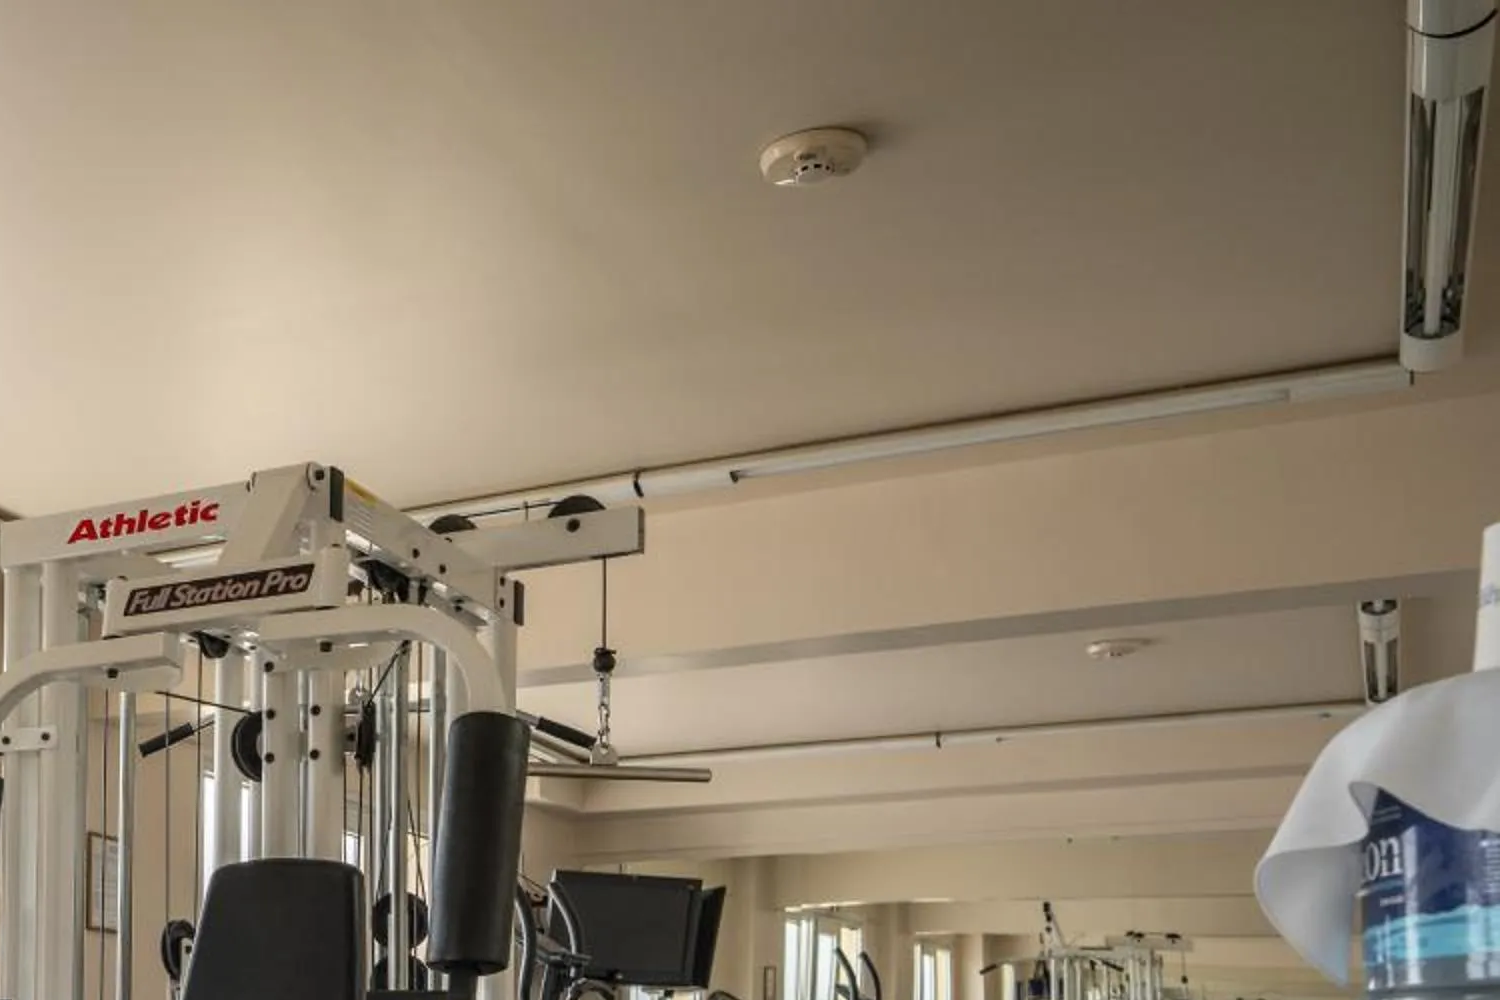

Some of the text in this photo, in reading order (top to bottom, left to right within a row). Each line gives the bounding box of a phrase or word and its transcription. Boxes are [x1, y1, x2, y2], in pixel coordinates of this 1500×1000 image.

[67, 500, 219, 544] Athletic
[129, 571, 308, 613] Full Station Pro
